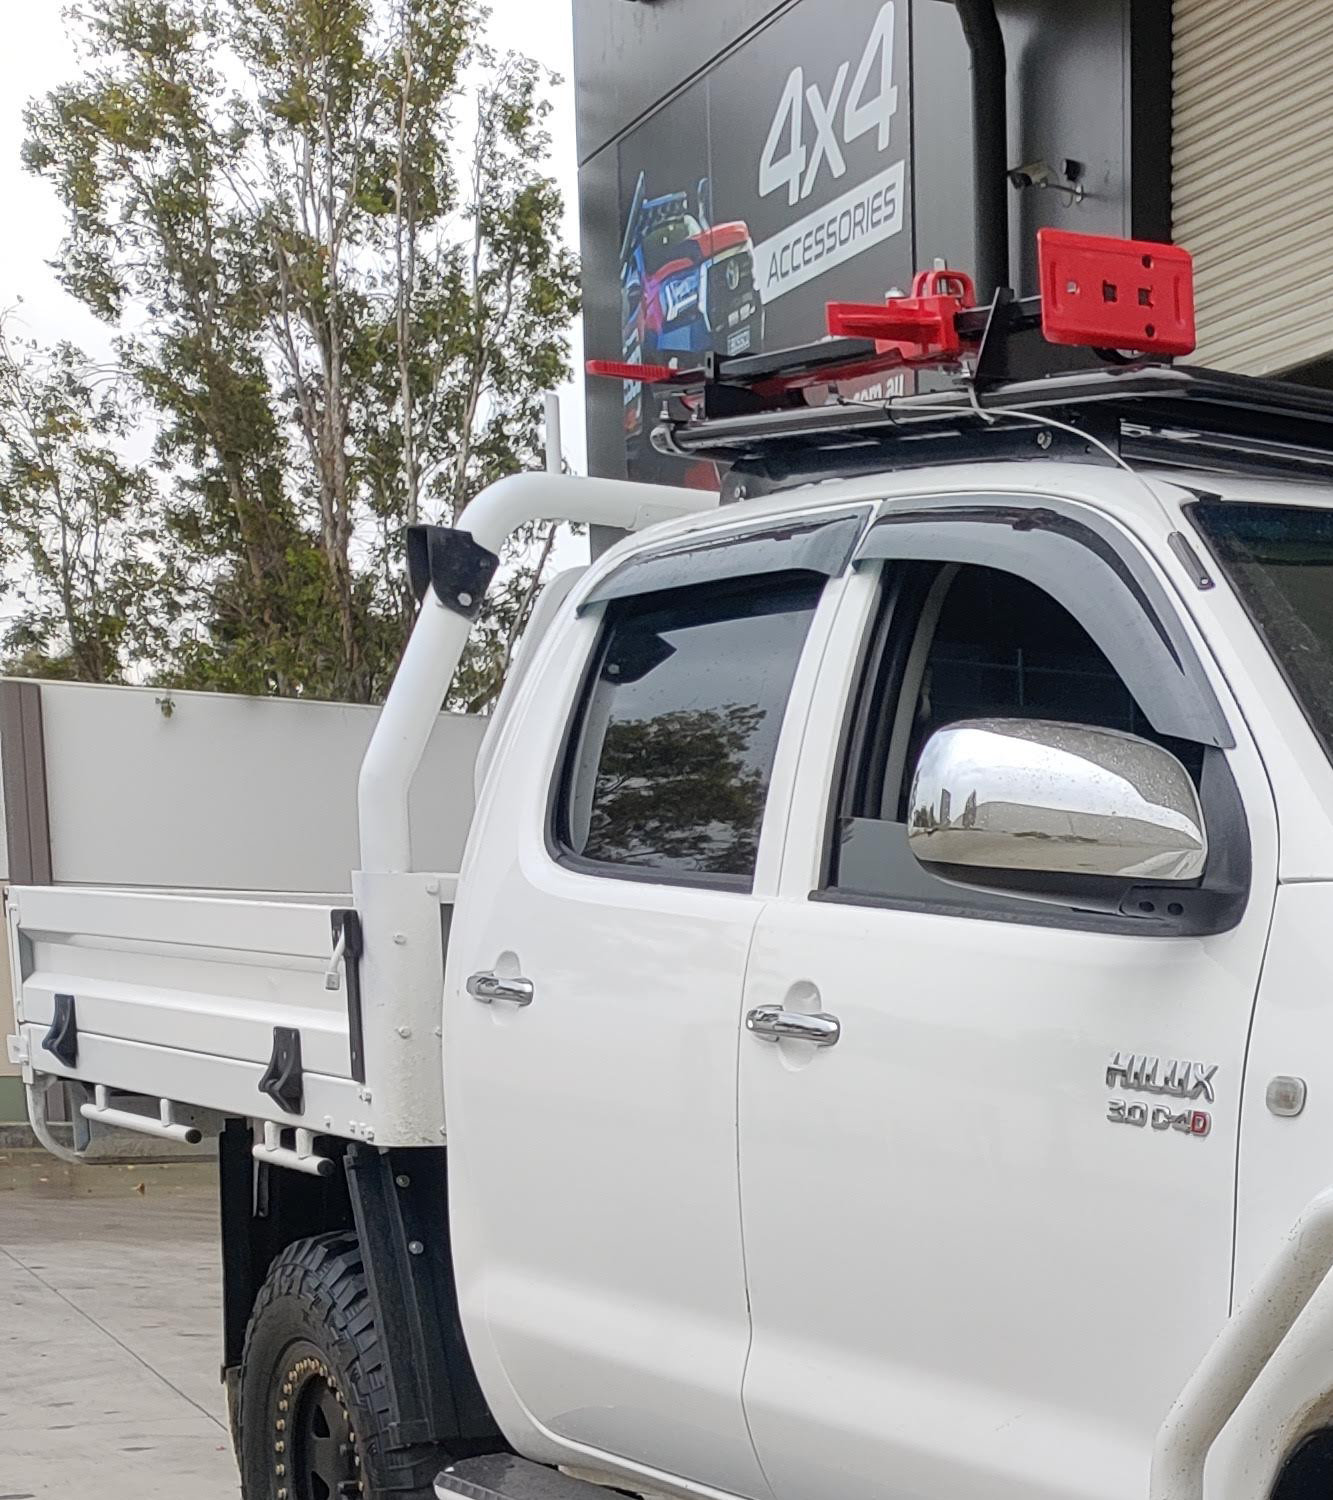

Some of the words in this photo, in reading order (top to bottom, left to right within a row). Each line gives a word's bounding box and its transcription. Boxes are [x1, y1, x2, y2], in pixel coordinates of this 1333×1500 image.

[759, 1, 898, 206] 4x4
[767, 182, 897, 288] ACCESSORIES
[1106, 1051, 1219, 1103] HILUX
